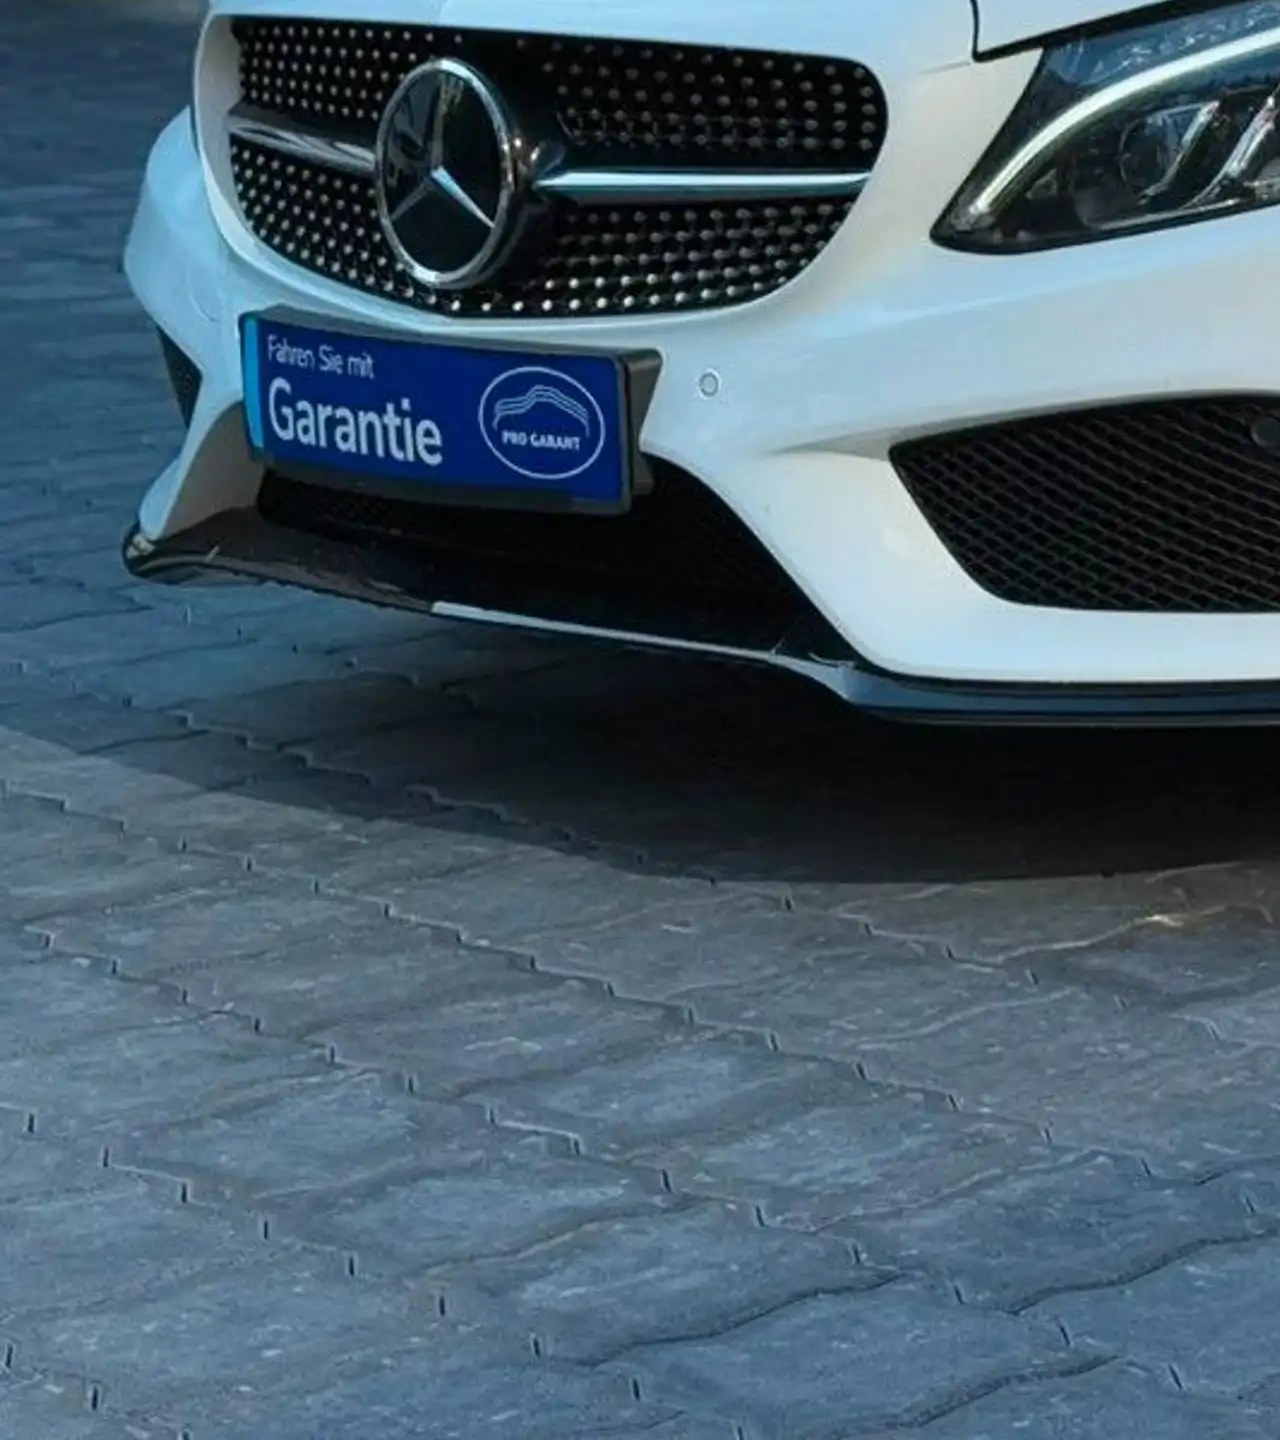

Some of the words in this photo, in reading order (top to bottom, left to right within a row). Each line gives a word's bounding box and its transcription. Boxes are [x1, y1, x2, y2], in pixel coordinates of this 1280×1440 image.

[267, 334, 316, 372] Fahren
[319, 344, 343, 375] Sie
[347, 350, 376, 380] mit
[268, 376, 444, 467] Garantie
[501, 429, 528, 447] PRO
